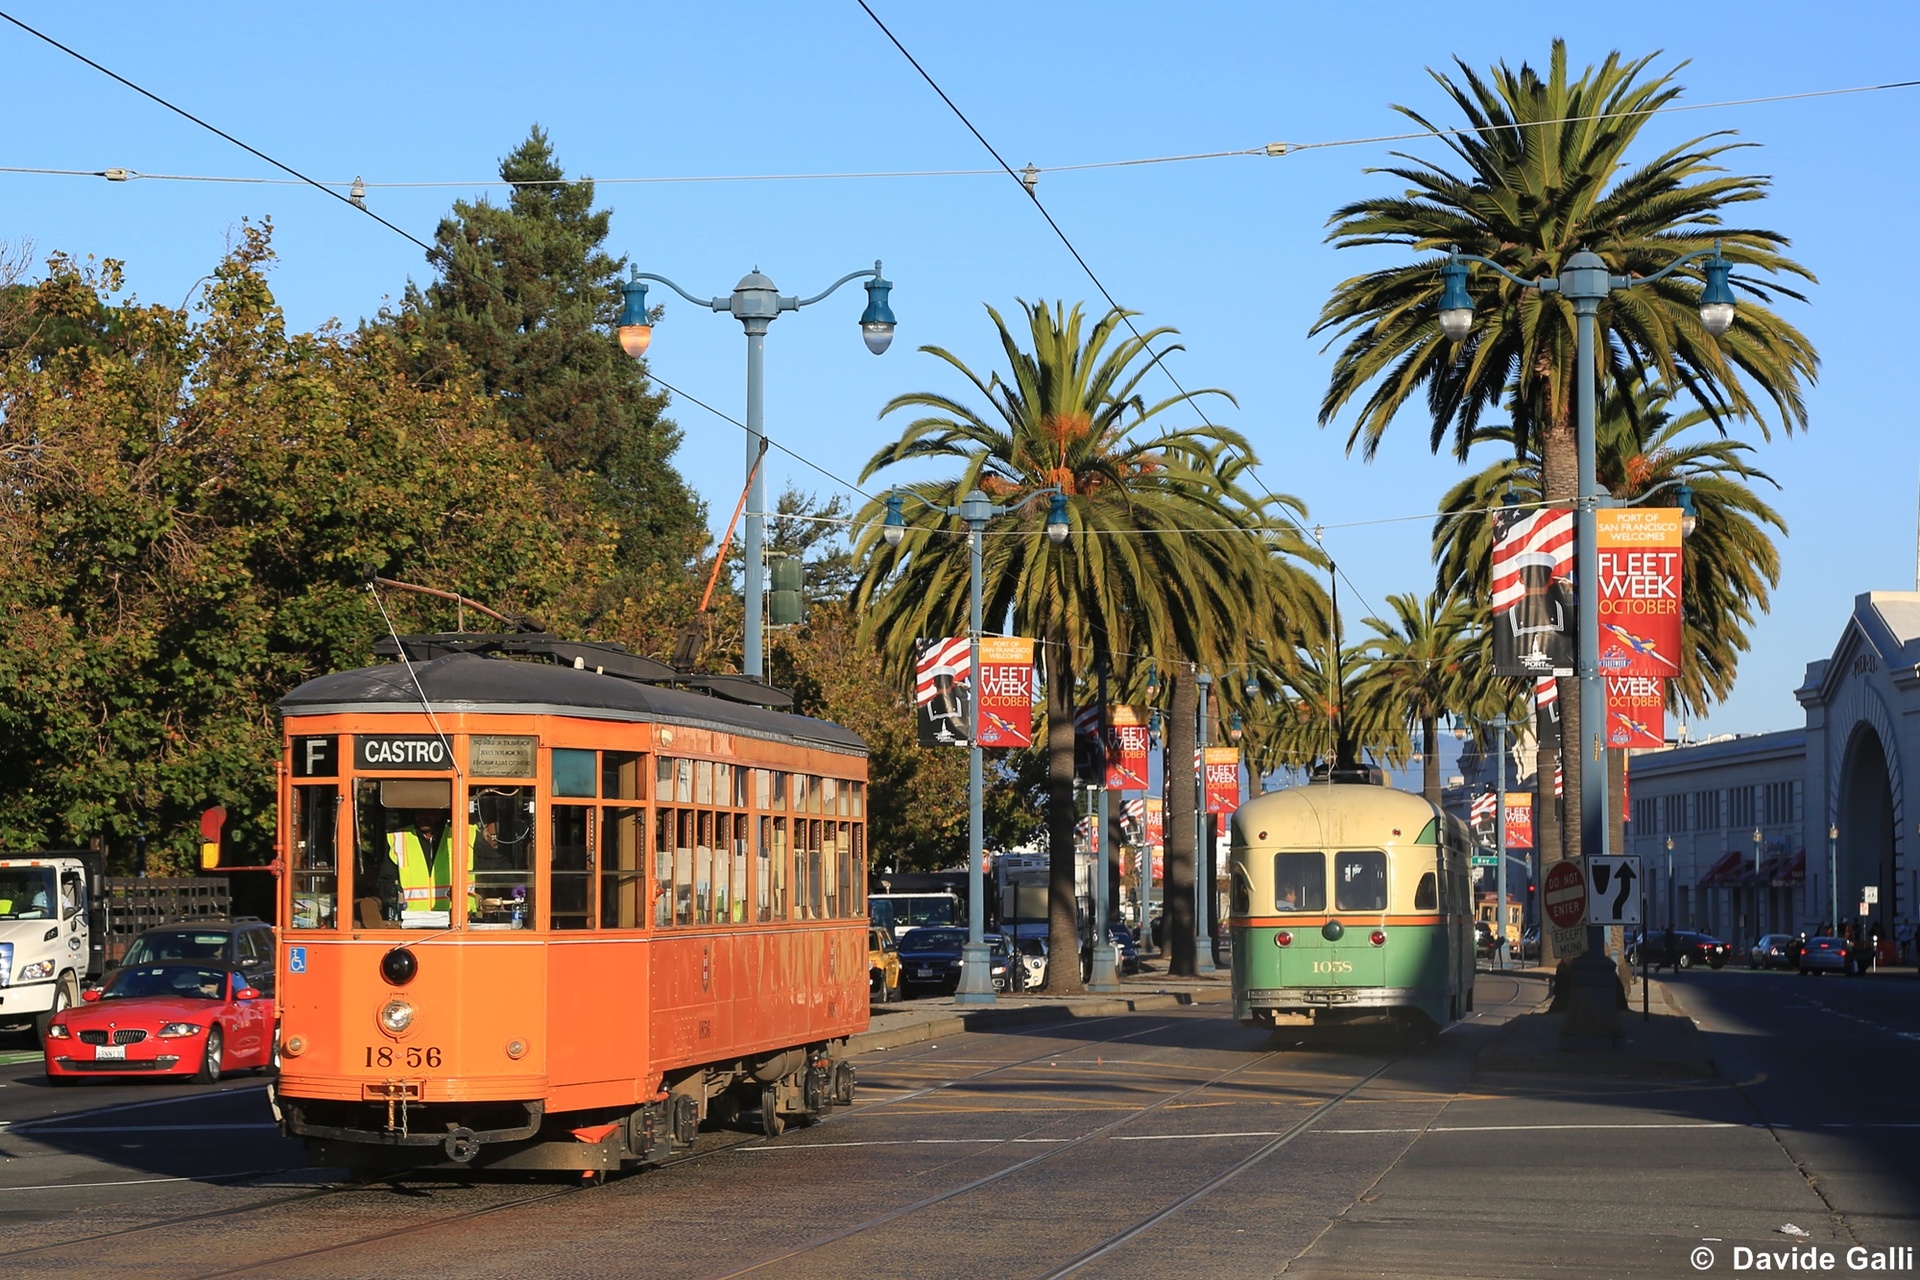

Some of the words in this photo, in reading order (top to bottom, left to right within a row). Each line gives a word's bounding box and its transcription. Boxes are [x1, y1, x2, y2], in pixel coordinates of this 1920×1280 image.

[1616, 513, 1643, 523] PORT
[1644, 513, 1660, 523] OF
[1599, 523, 1620, 532] SAN
[1621, 523, 1677, 532] FRANCISCO
[1610, 532, 1665, 541] WELCOMES
[1598, 553, 1677, 576] FLEET
[1598, 575, 1677, 598] WEEK
[1599, 600, 1677, 615] OCTOBER
[981, 666, 1031, 682] FLEET
[981, 681, 1029, 696] WEEK
[1608, 680, 1661, 696] WEEK
[981, 696, 1030, 707] OCTOBER
[1608, 696, 1661, 707] OCTOBER
[1107, 727, 1147, 739] FLEET
[1108, 739, 1146, 751] WEEK
[306, 740, 327, 775] F
[365, 740, 444, 763] CASTRO
[1206, 764, 1237, 775] FLEET
[1207, 774, 1237, 783] WEEK
[1147, 811, 1163, 819] FLEE
[1504, 807, 1531, 815] FLEET
[1147, 818, 1163, 826] WEE
[1505, 814, 1531, 823] WEEK
[1549, 877, 1559, 889] DO
[1564, 872, 1578, 885] NOT
[1553, 903, 1580, 917] ENTER
[1555, 927, 1584, 943] EXCEPT
[1559, 941, 1582, 955] MUNI
[1313, 961, 1353, 974] 1058
